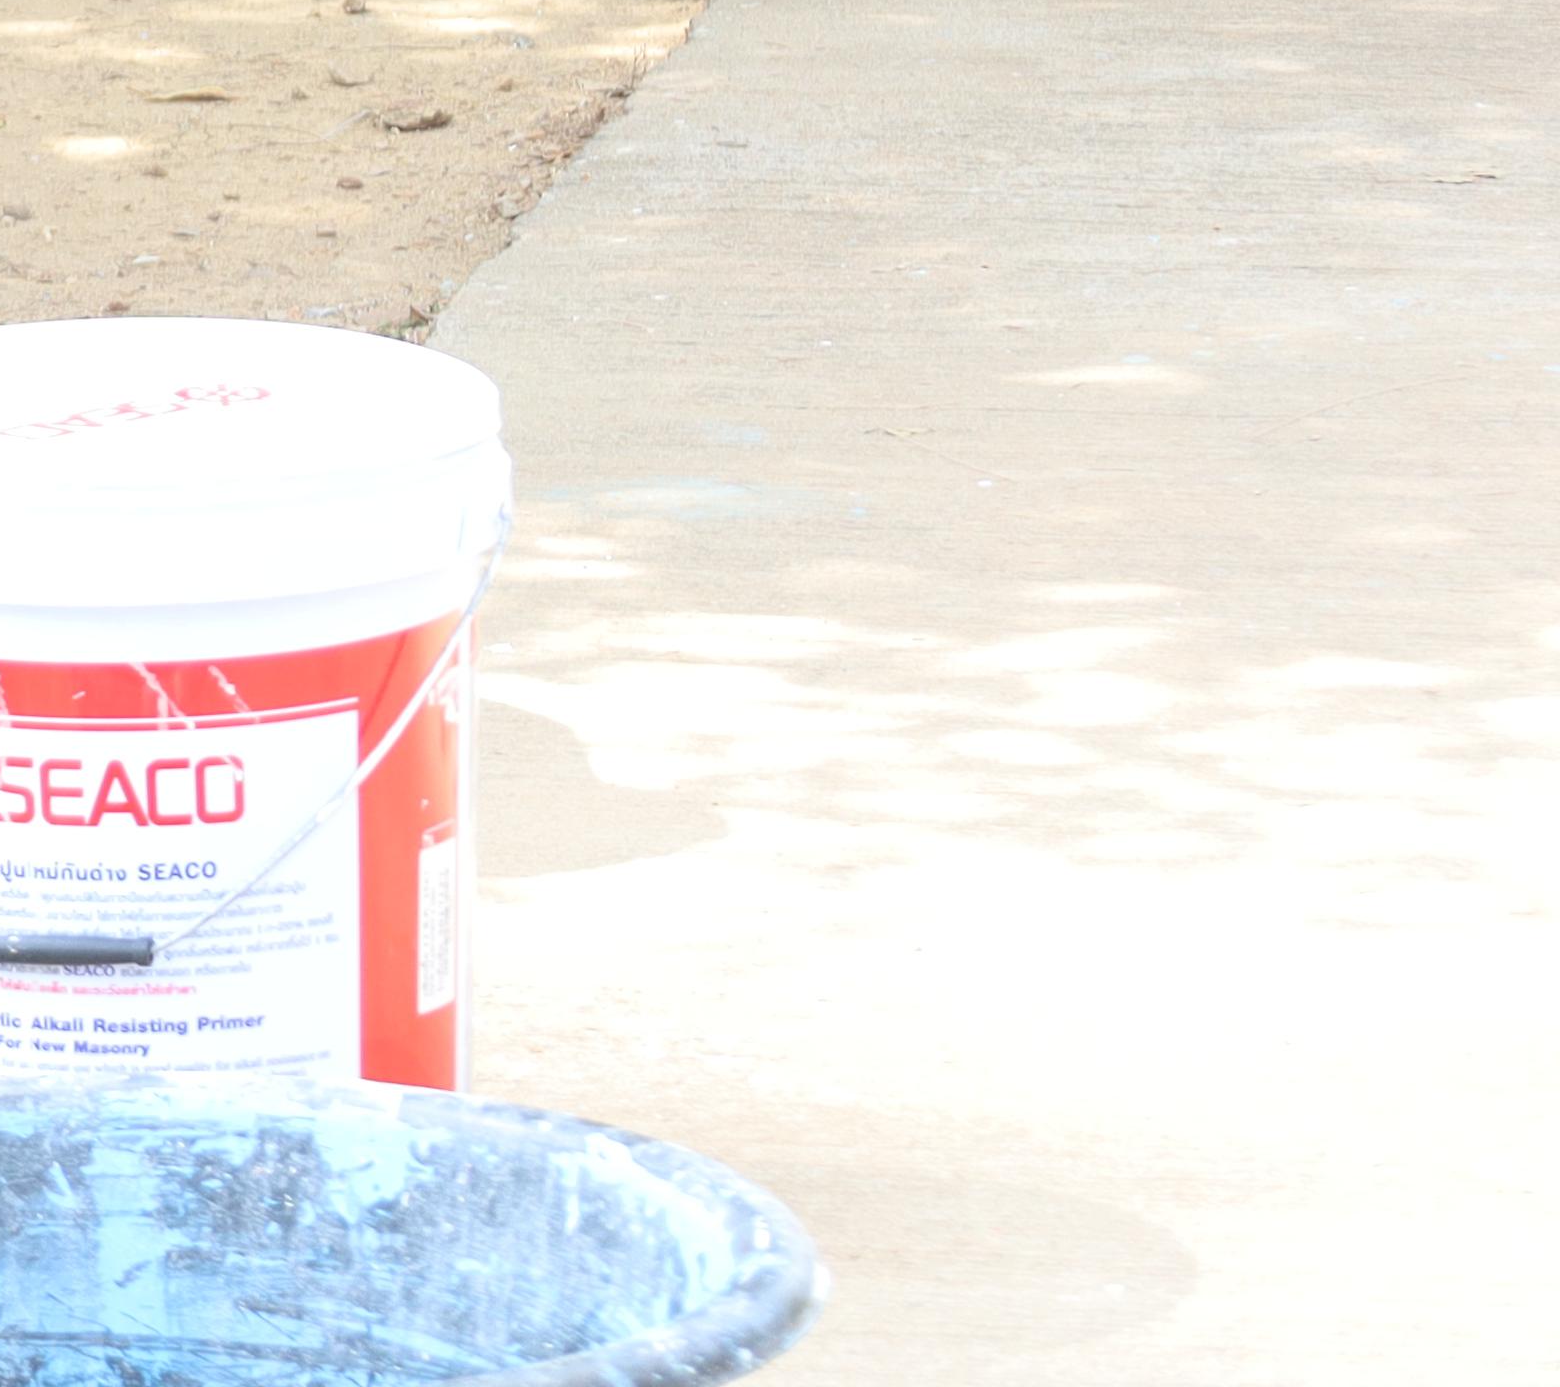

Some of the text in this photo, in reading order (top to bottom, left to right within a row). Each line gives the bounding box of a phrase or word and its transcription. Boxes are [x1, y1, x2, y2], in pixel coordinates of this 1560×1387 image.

[137, 860, 219, 882] SEACO
[29, 1015, 84, 1033] Alkali
[92, 1016, 189, 1036] Resisting
[196, 1014, 267, 1032] Primer
[29, 1037, 66, 1054] New
[72, 1039, 151, 1058] Masonry
